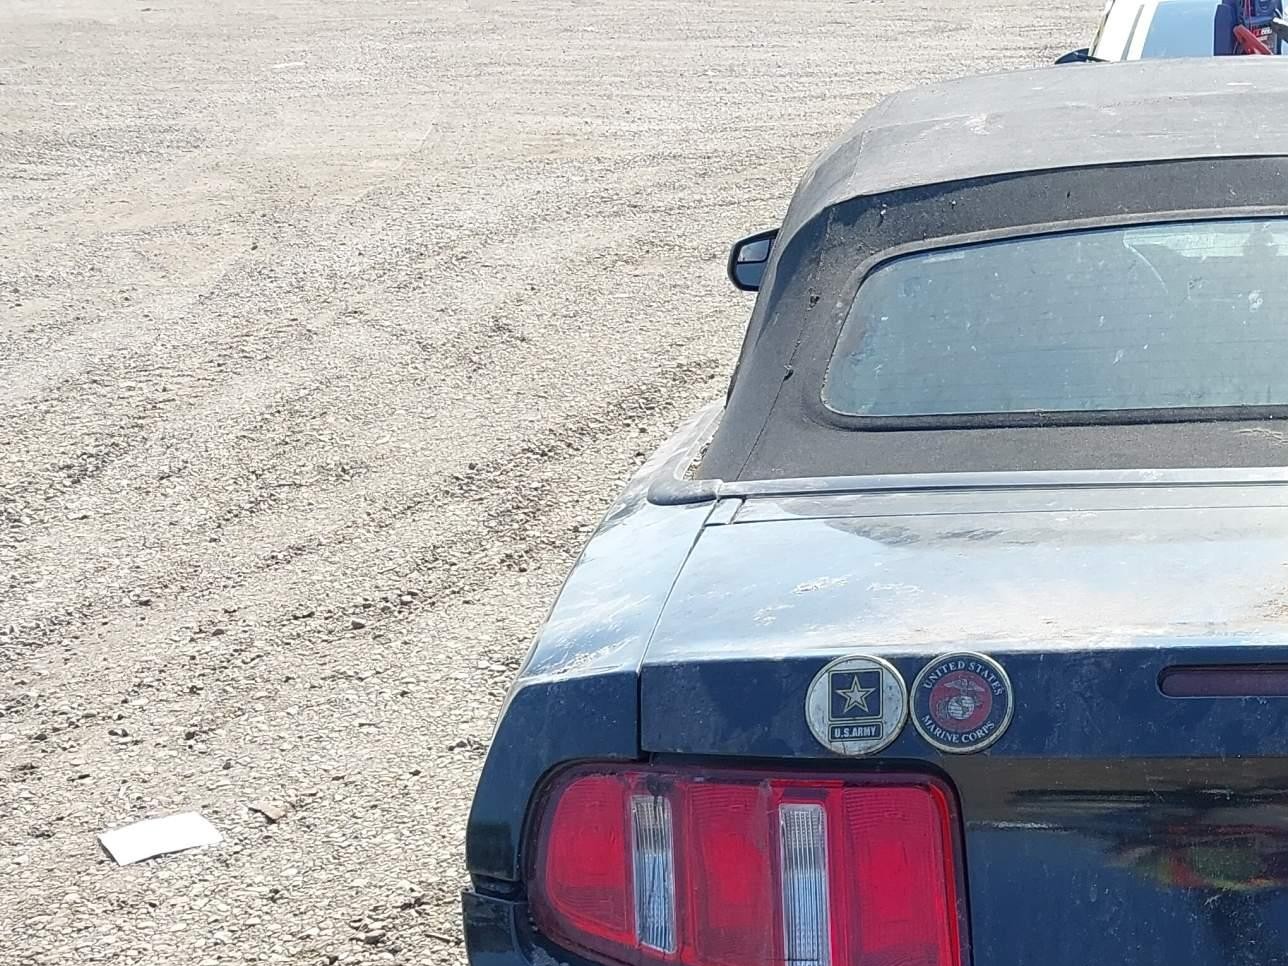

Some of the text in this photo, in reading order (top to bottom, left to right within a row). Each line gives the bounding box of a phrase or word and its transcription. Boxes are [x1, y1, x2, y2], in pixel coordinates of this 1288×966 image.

[923, 660, 1005, 697] UNITED STATES
[921, 715, 996, 743] MARINE CORPS
